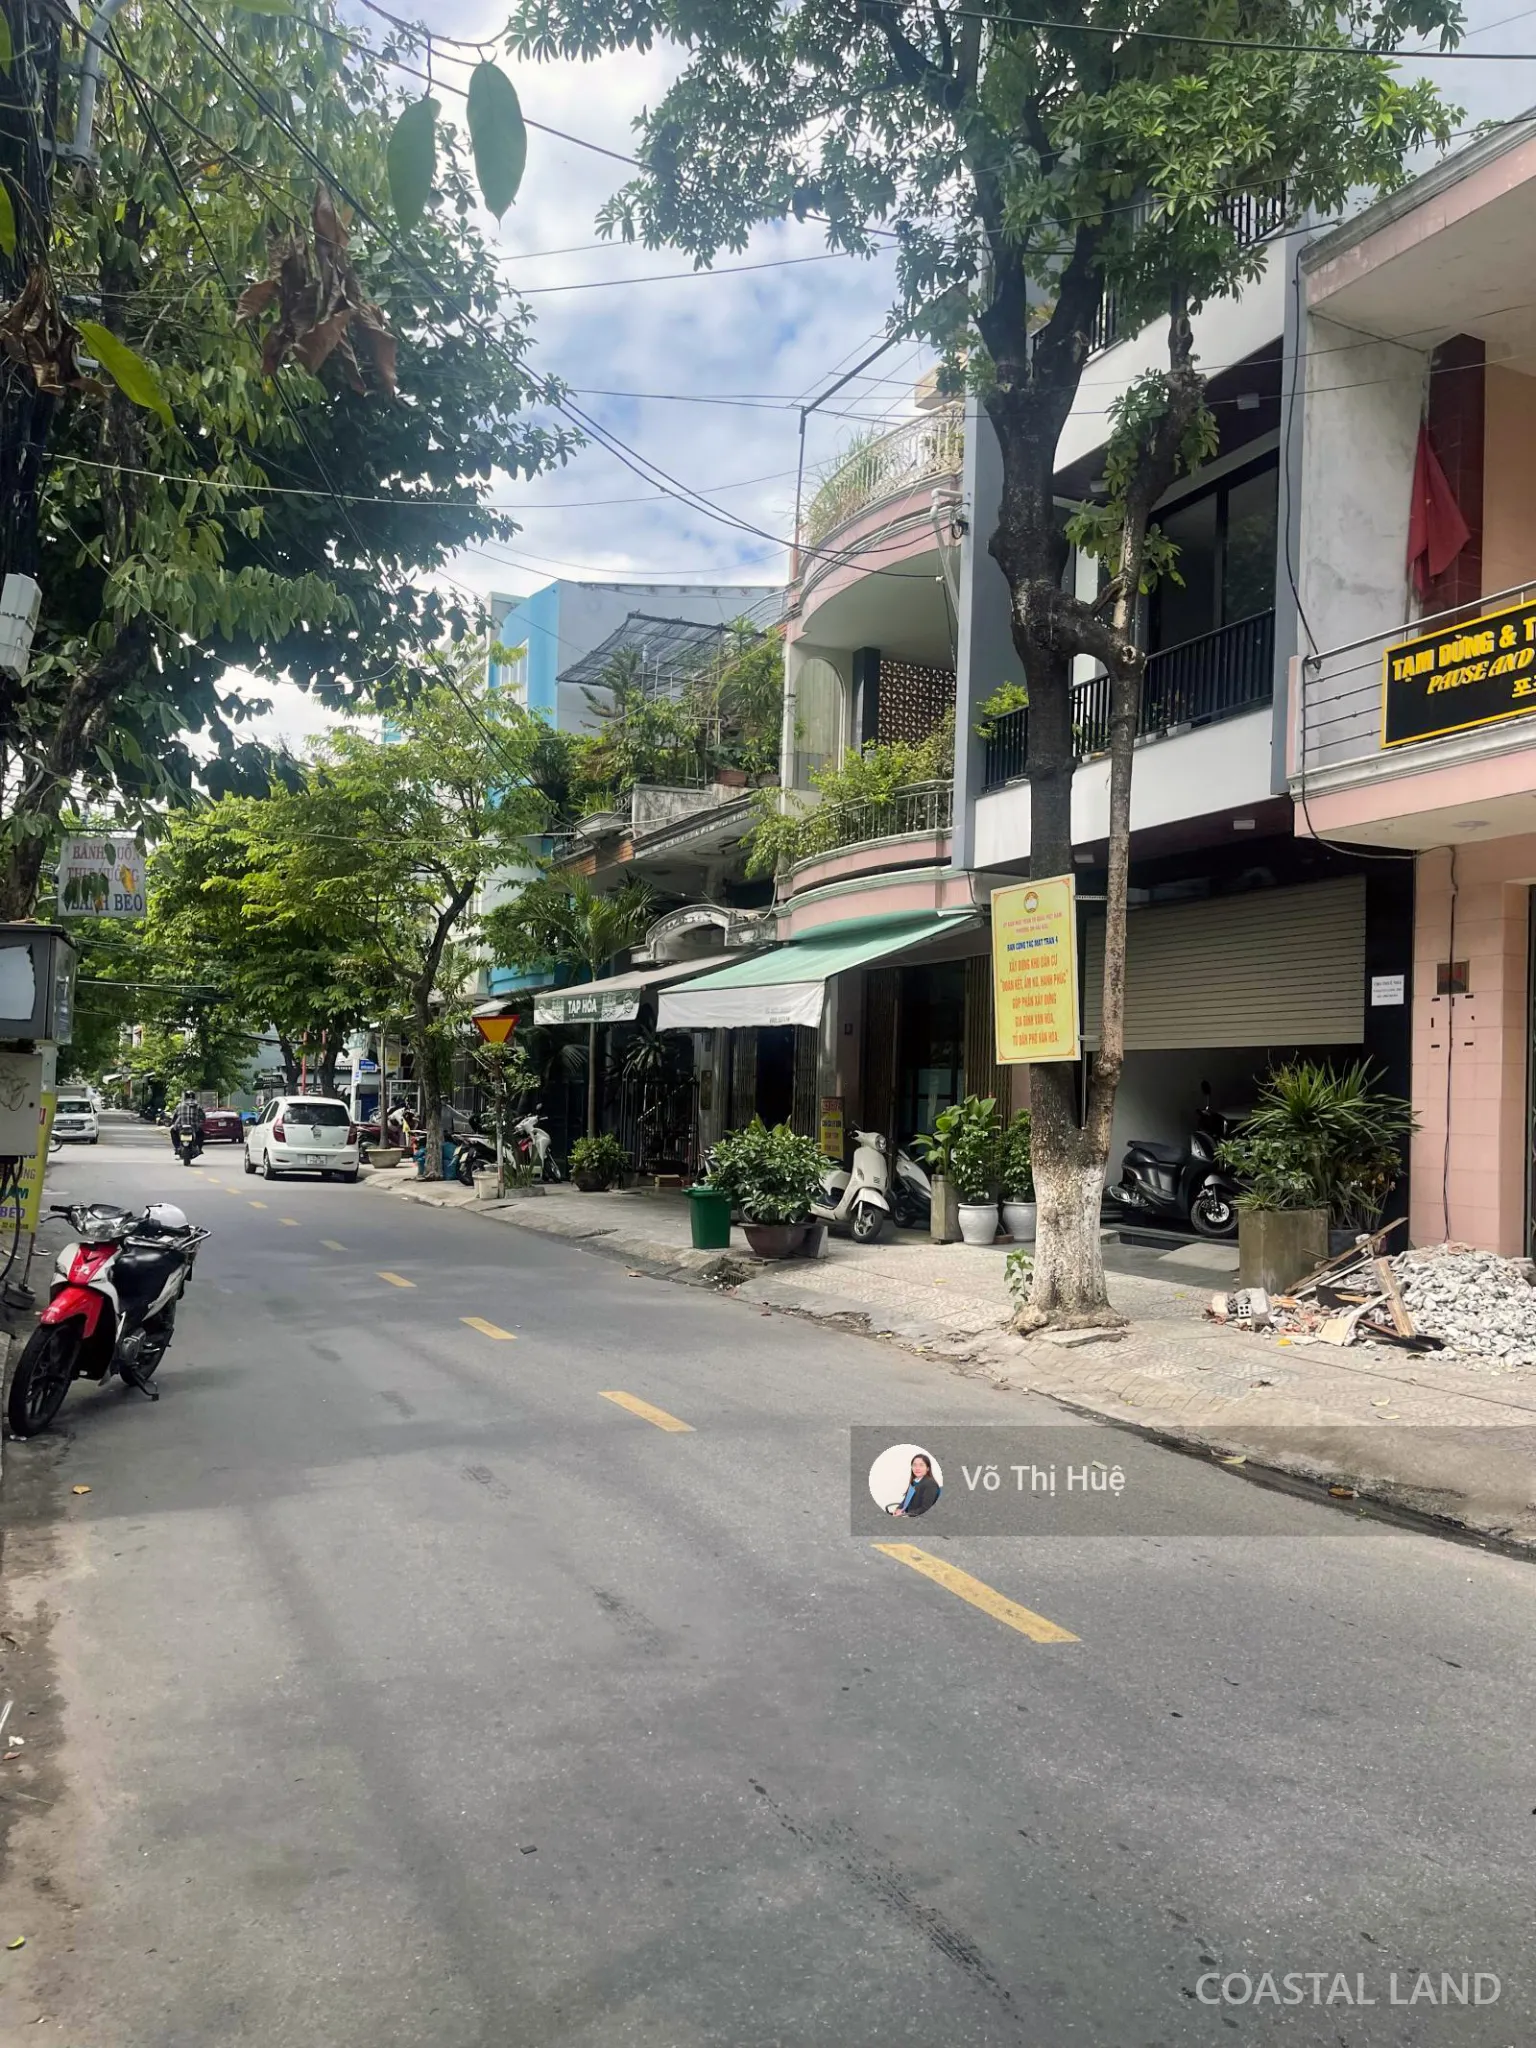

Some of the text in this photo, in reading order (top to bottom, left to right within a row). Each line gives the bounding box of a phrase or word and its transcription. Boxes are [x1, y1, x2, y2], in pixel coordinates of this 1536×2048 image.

[1392, 649, 1434, 683] TẠM
[1499, 624, 1517, 649] &
[1523, 616, 1536, 642] T
[1427, 647, 1535, 695] PAUSE AND
[1511, 675, 1536, 698] 포
[568, 1000, 581, 1017] TẠP
